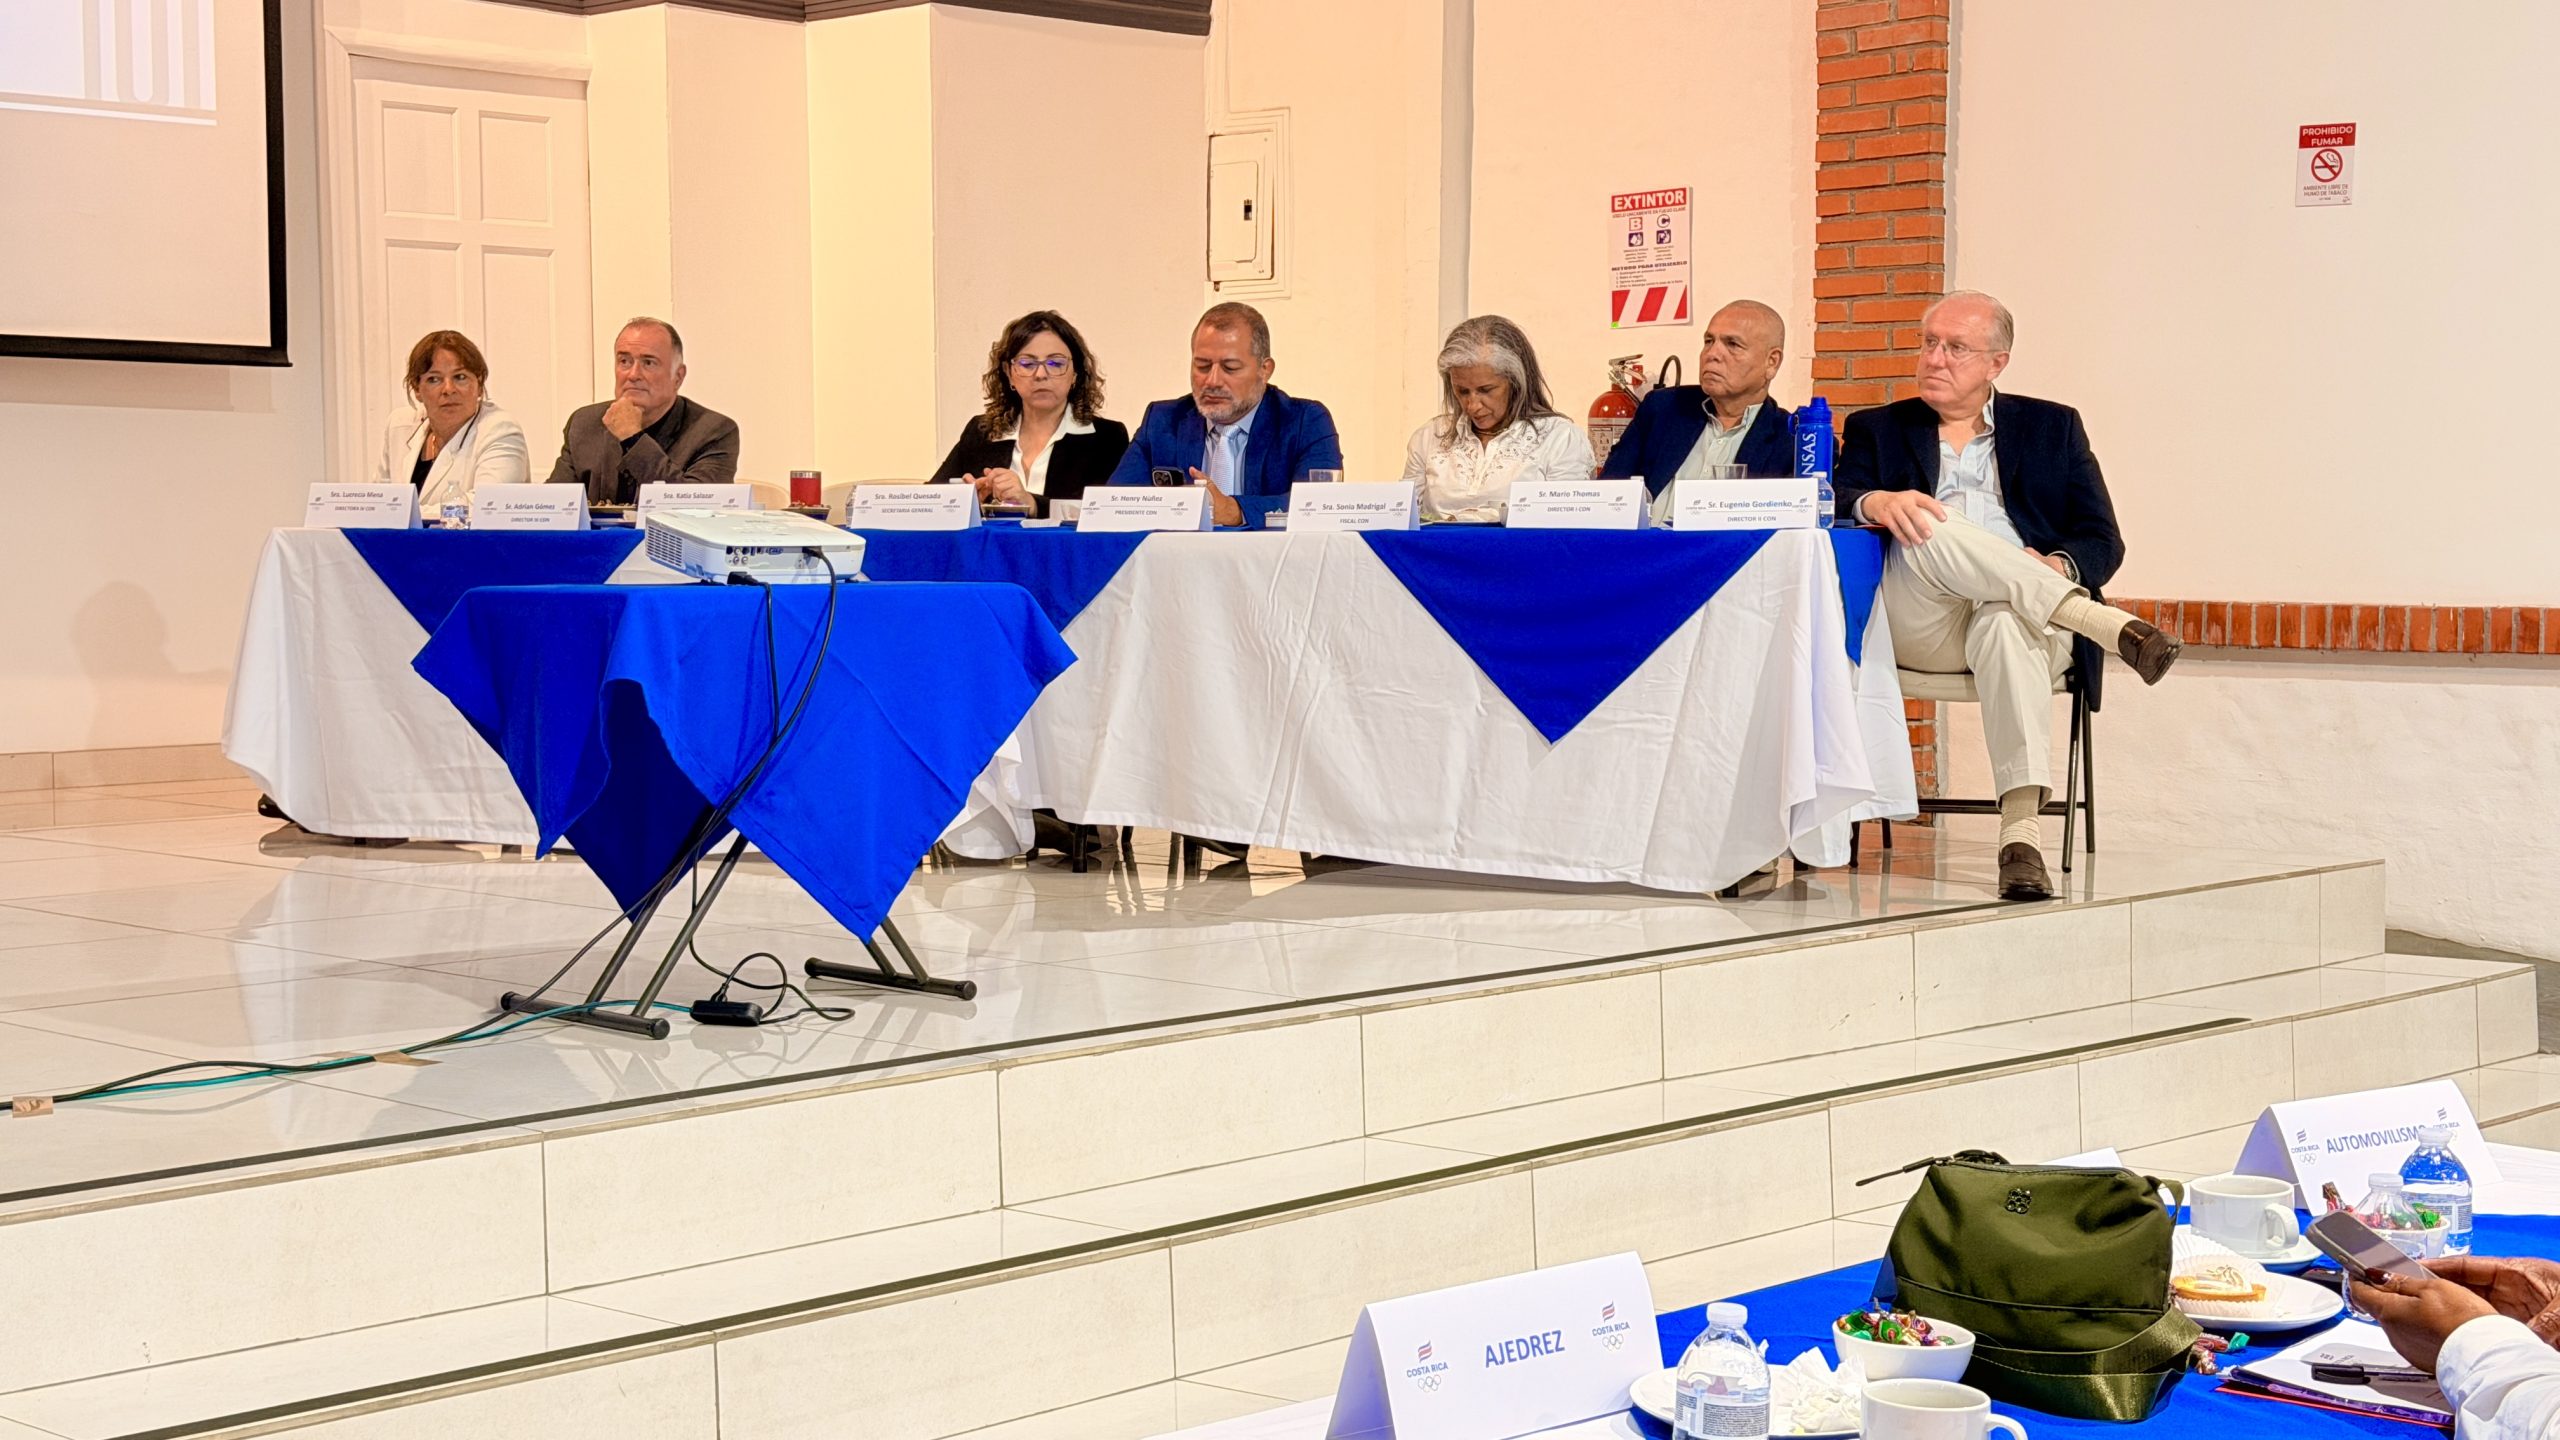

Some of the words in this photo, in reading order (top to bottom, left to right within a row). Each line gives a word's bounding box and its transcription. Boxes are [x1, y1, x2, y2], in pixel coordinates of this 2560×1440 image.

[2302, 126, 2353, 136] PROHIBIDO
[2311, 137, 2343, 146] FUMAR
[1614, 190, 1685, 211] EXTINTOR
[1658, 215, 1670, 227] C
[1356, 503, 1386, 511] Madrigal
[1720, 501, 1750, 509] Eugenio
[2308, 1144, 2320, 1152] RICA
[1592, 1326, 1614, 1336] COSTA
[1614, 1321, 1630, 1332] RICA
[1485, 1330, 1565, 1368] AJEDREZ
[1407, 1366, 1430, 1378] COSTA
[1431, 1362, 1449, 1372] RICA
